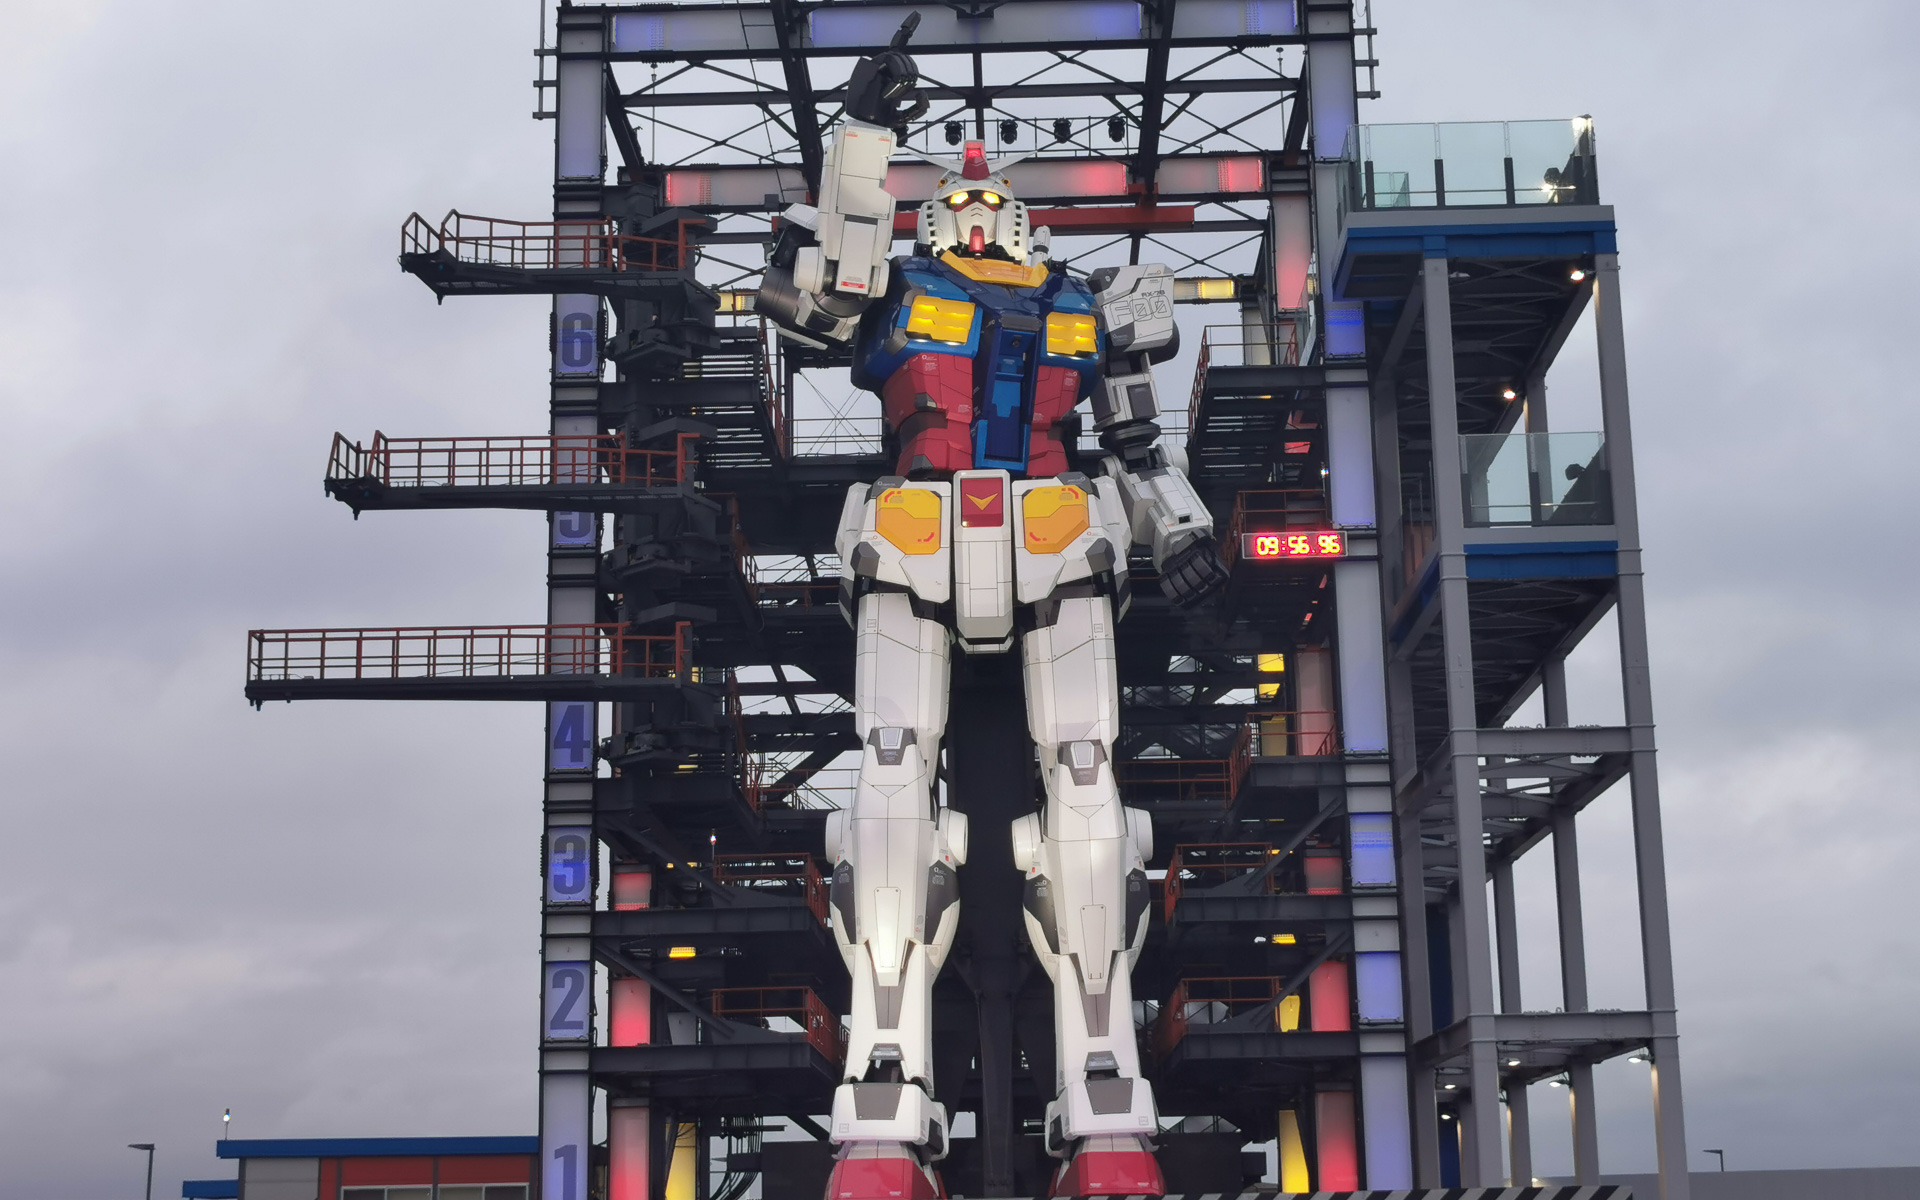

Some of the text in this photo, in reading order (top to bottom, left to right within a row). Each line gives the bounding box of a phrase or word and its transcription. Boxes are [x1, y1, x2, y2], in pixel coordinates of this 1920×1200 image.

[562, 312, 593, 367] 6
[554, 705, 590, 762] 4
[554, 835, 586, 894] 3
[550, 968, 584, 1030] 2
[554, 1144, 577, 1200] 1
